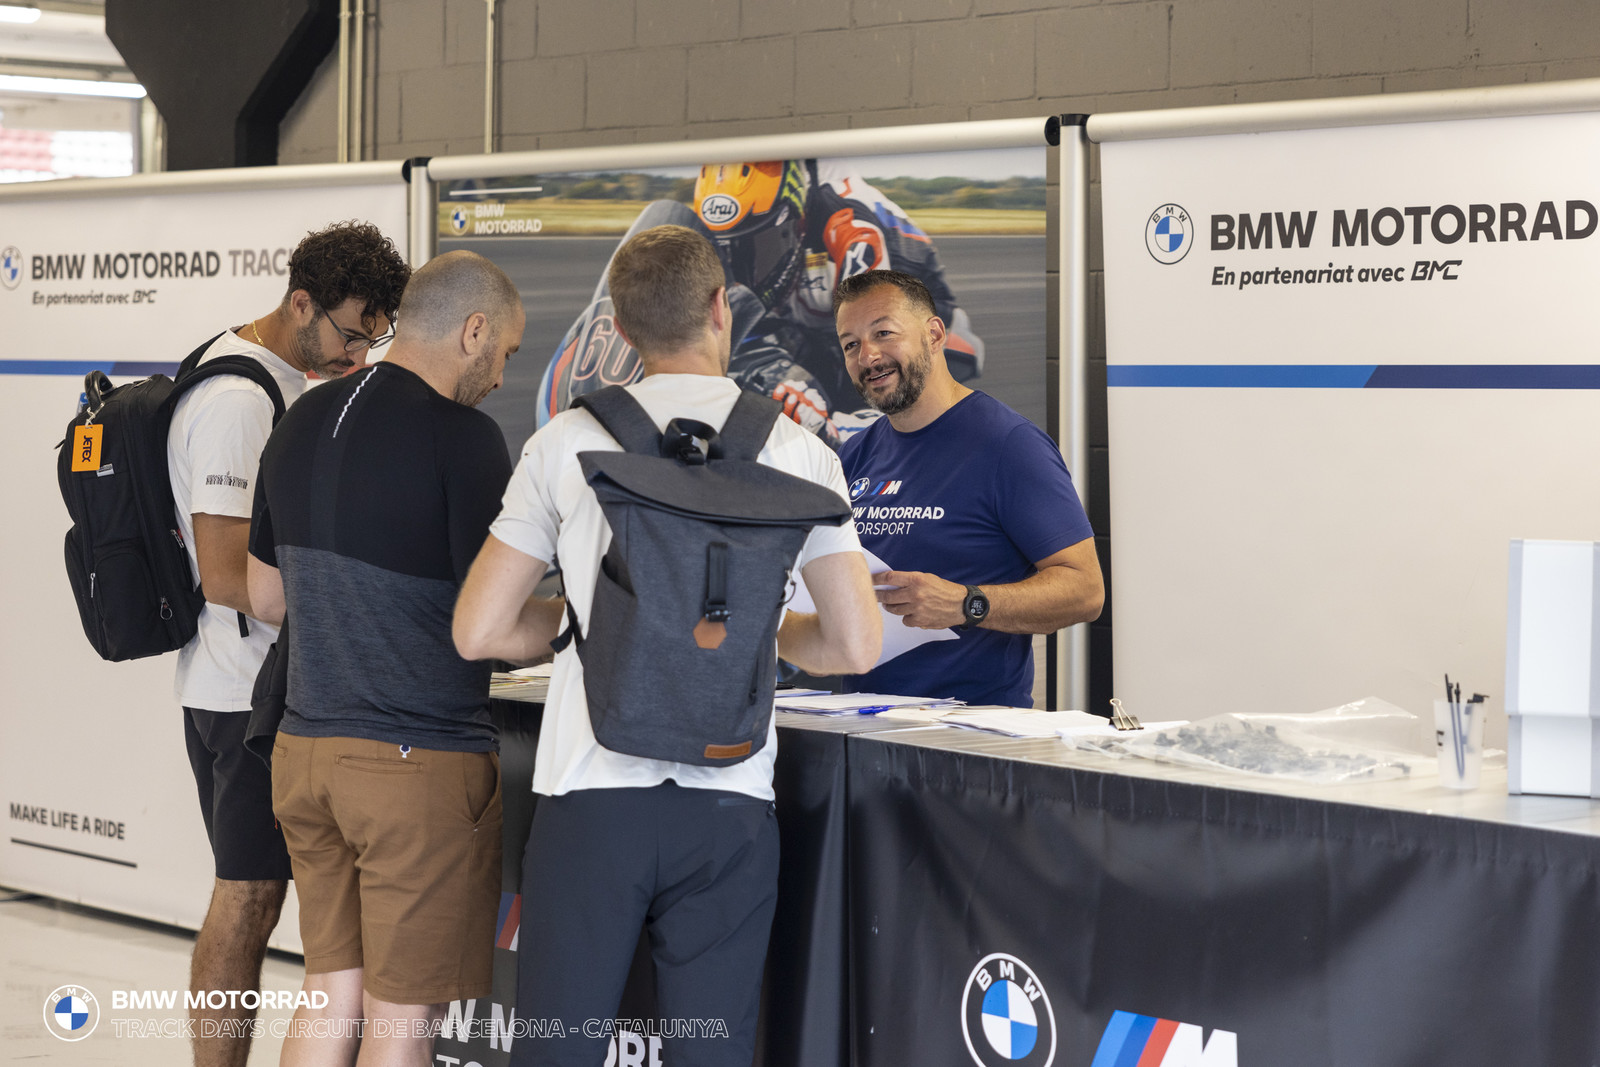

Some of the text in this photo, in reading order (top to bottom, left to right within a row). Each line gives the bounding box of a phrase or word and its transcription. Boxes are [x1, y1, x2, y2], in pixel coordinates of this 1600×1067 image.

[475, 204, 505, 219] BMW
[704, 200, 735, 215] Arai
[474, 218, 543, 234] MOTORRAD
[1210, 200, 1598, 251] BMW MOTORRAD
[31, 253, 86, 280] BMW
[93, 251, 221, 279] MOTORRAD
[228, 249, 294, 276] TRAC
[1211, 266, 1236, 286] En
[1238, 262, 1355, 291] partenariat
[1357, 267, 1406, 283] avec
[32, 291, 45, 305] En
[46, 289, 104, 308] partenariat
[105, 293, 129, 304] avec
[81, 435, 93, 462] JETEX
[866, 506, 945, 520] MOTORRAD
[10, 802, 126, 840] MAKE LIFE A RIDE
